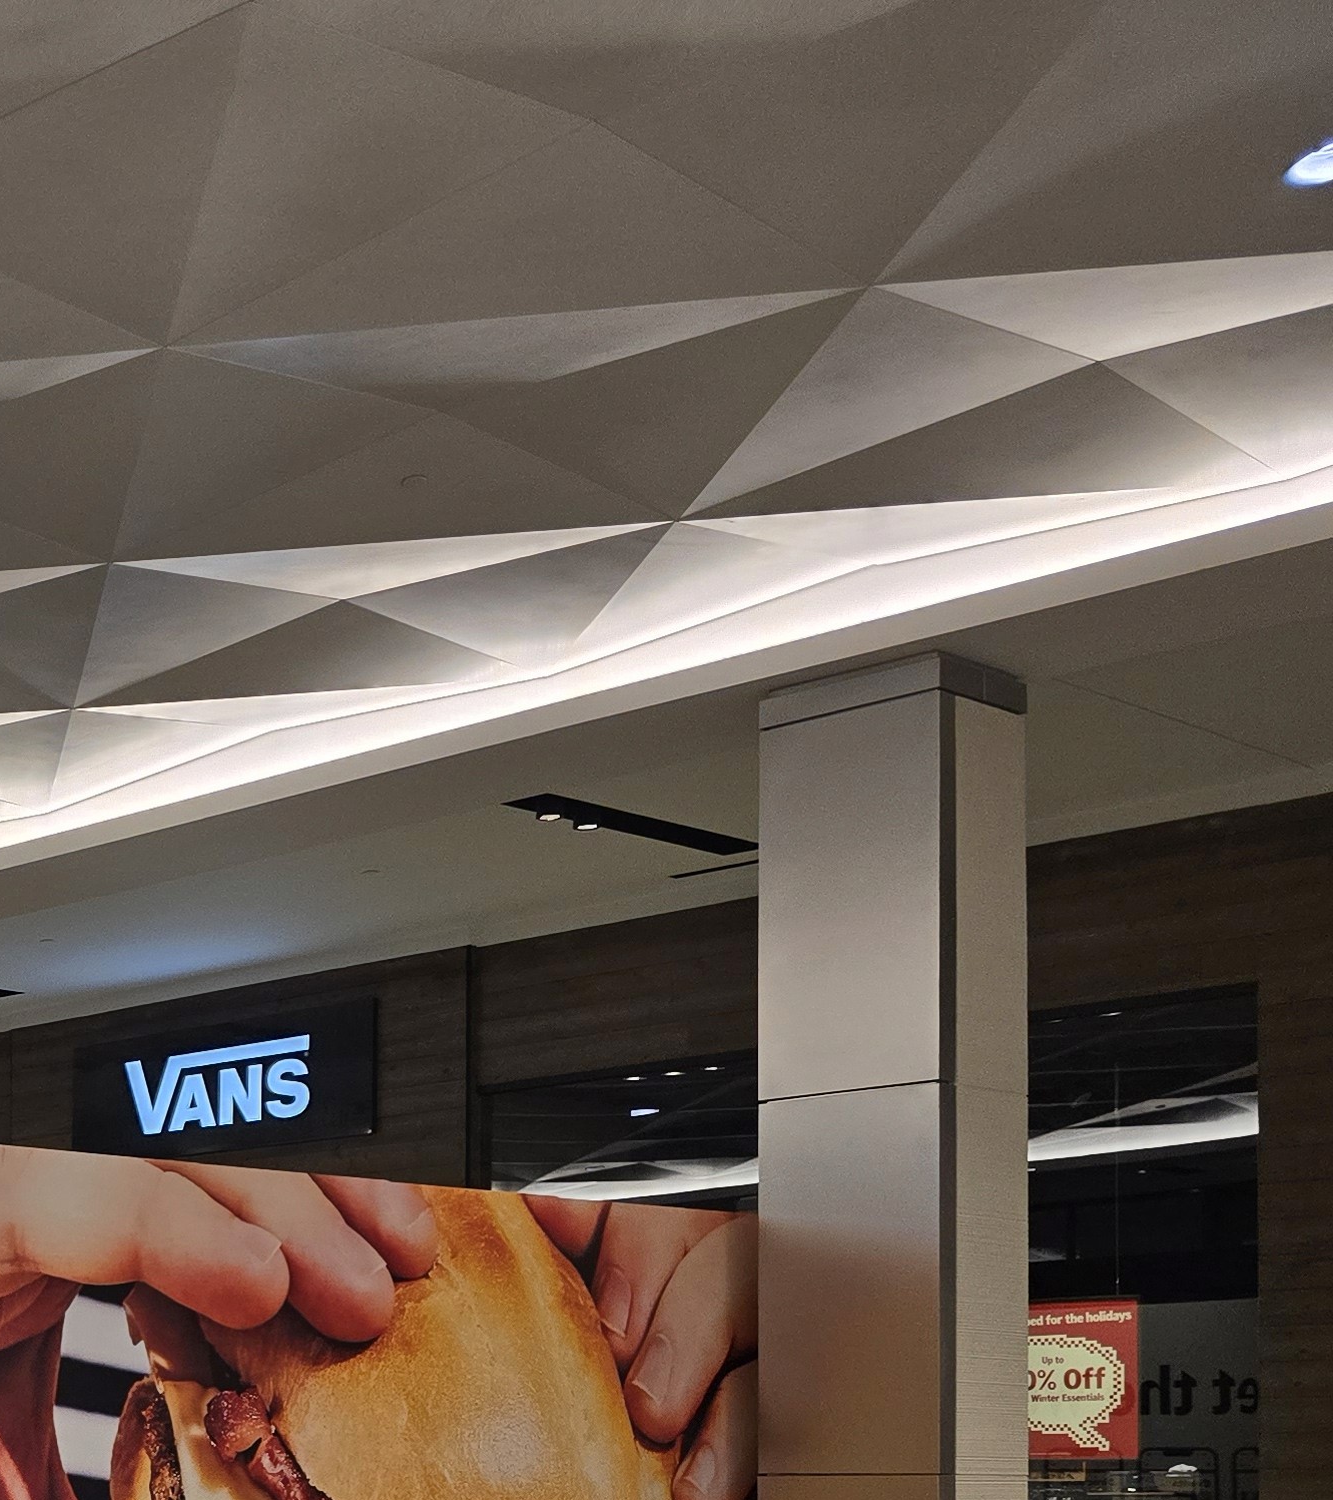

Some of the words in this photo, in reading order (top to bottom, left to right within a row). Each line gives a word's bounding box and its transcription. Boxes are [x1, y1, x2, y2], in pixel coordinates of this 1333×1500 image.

[124, 1034, 310, 1135] VANS
[1046, 1314, 1063, 1325] for
[1065, 1313, 1083, 1324] the
[1085, 1310, 1132, 1323] holidays
[1042, 1356, 1053, 1366] Up
[1055, 1356, 1064, 1364] to
[1063, 1367, 1106, 1390] Off
[1031, 1394, 1059, 1403] Winter
[1062, 1393, 1104, 1402] Essentials
